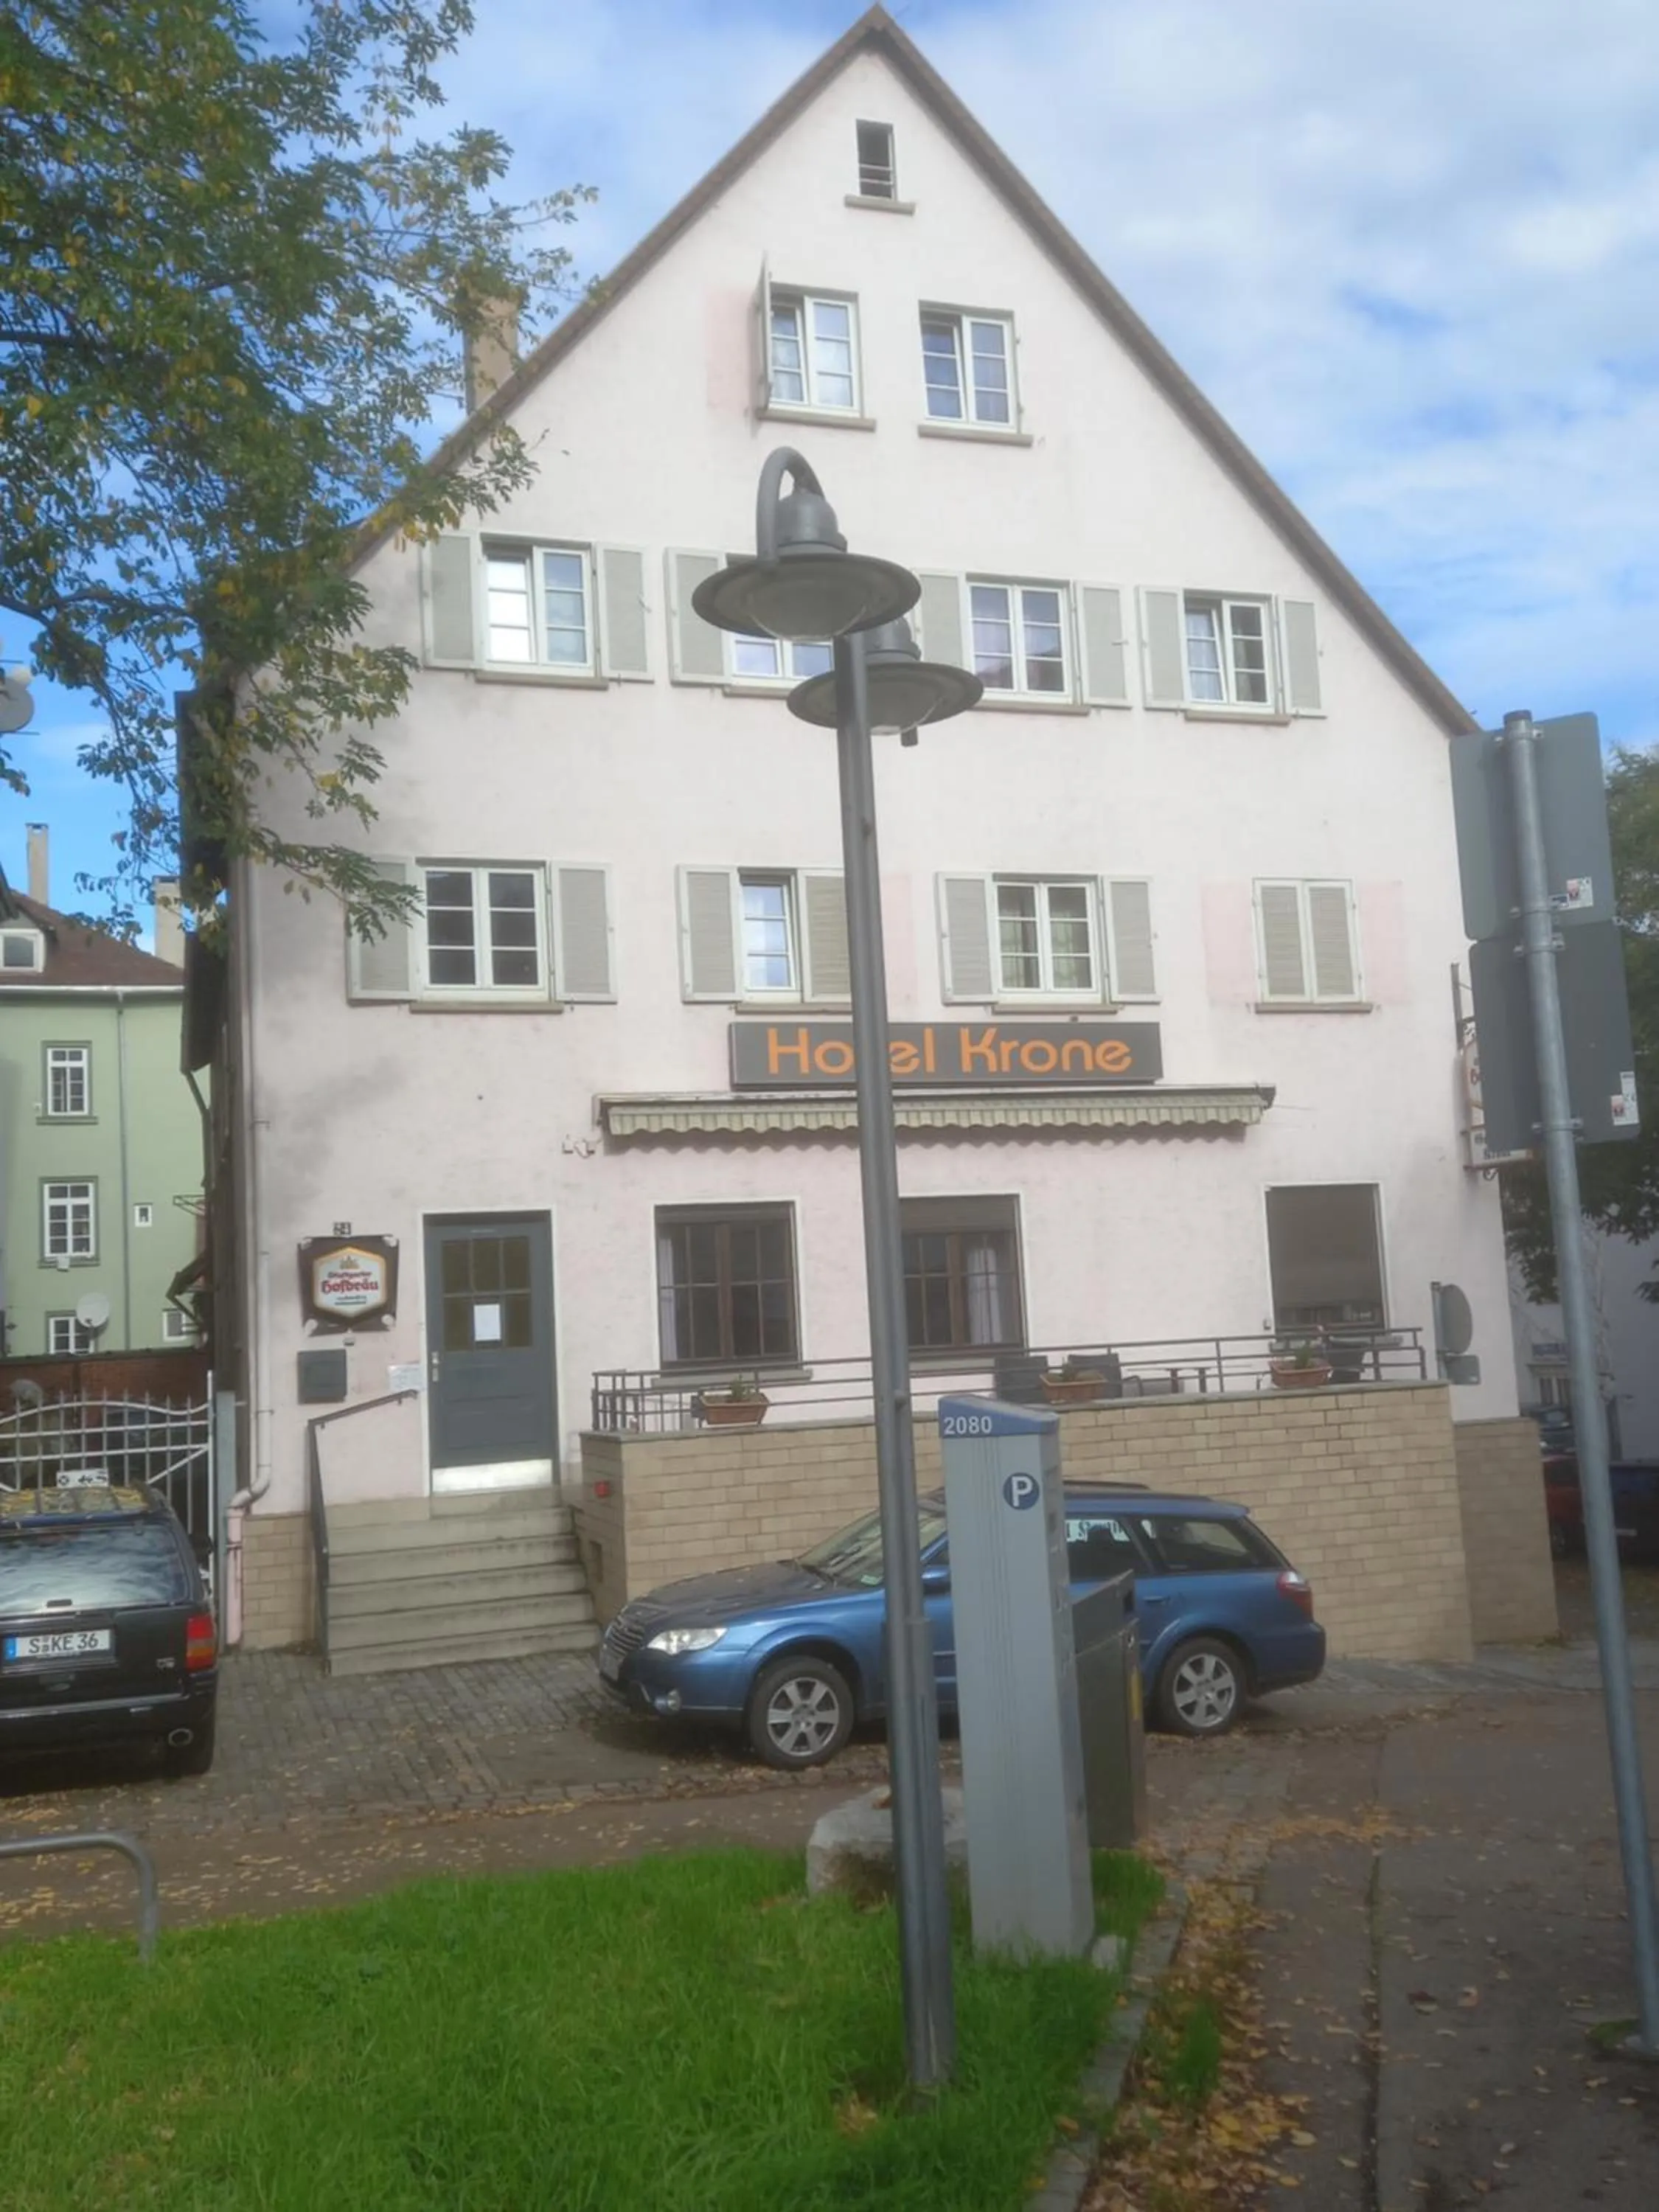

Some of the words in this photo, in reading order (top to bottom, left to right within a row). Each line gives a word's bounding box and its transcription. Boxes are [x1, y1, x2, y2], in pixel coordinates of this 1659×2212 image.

[768, 1028, 934, 1074] Hoel
[961, 1027, 1133, 1073] Krone
[944, 1416, 992, 1435] 2080
[1012, 1475, 1033, 1507] P
[77, 1632, 99, 1649] 36
